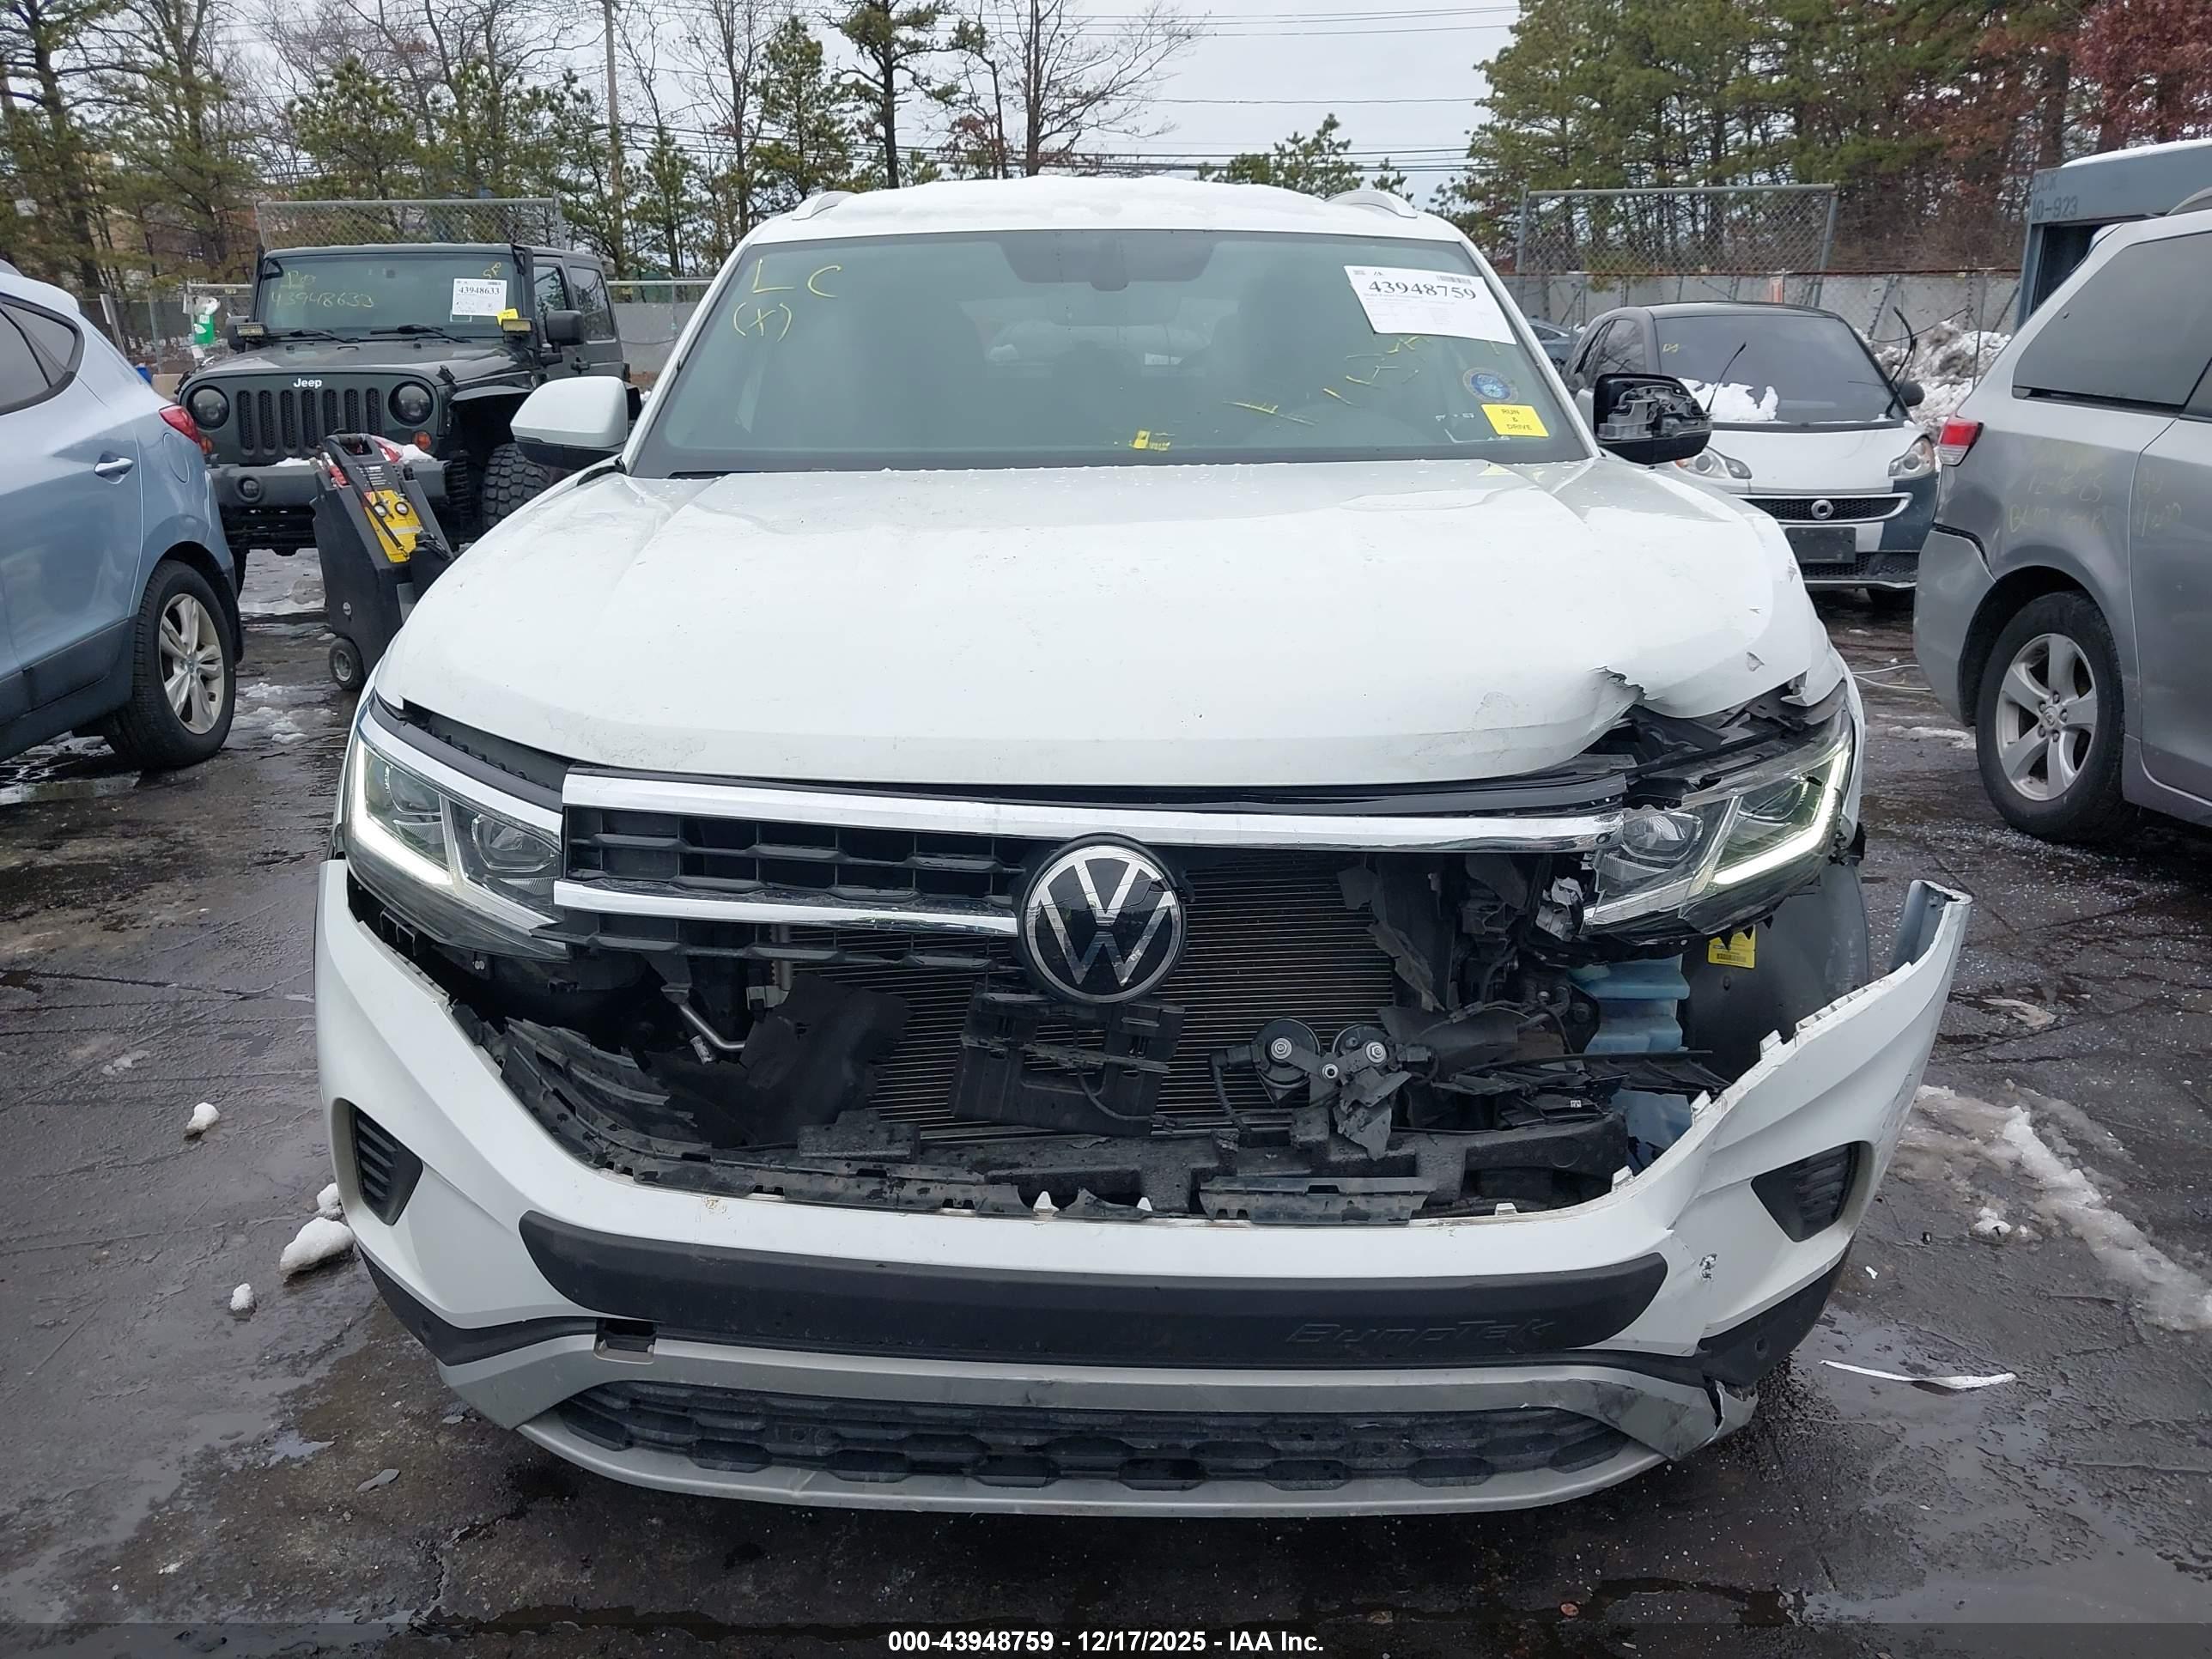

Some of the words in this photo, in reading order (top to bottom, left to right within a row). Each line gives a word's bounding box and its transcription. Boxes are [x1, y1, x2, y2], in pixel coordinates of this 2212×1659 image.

[458, 286, 501, 295] 43948633
[1368, 281, 1477, 301] 43948759
[293, 377, 323, 389] Jeep
